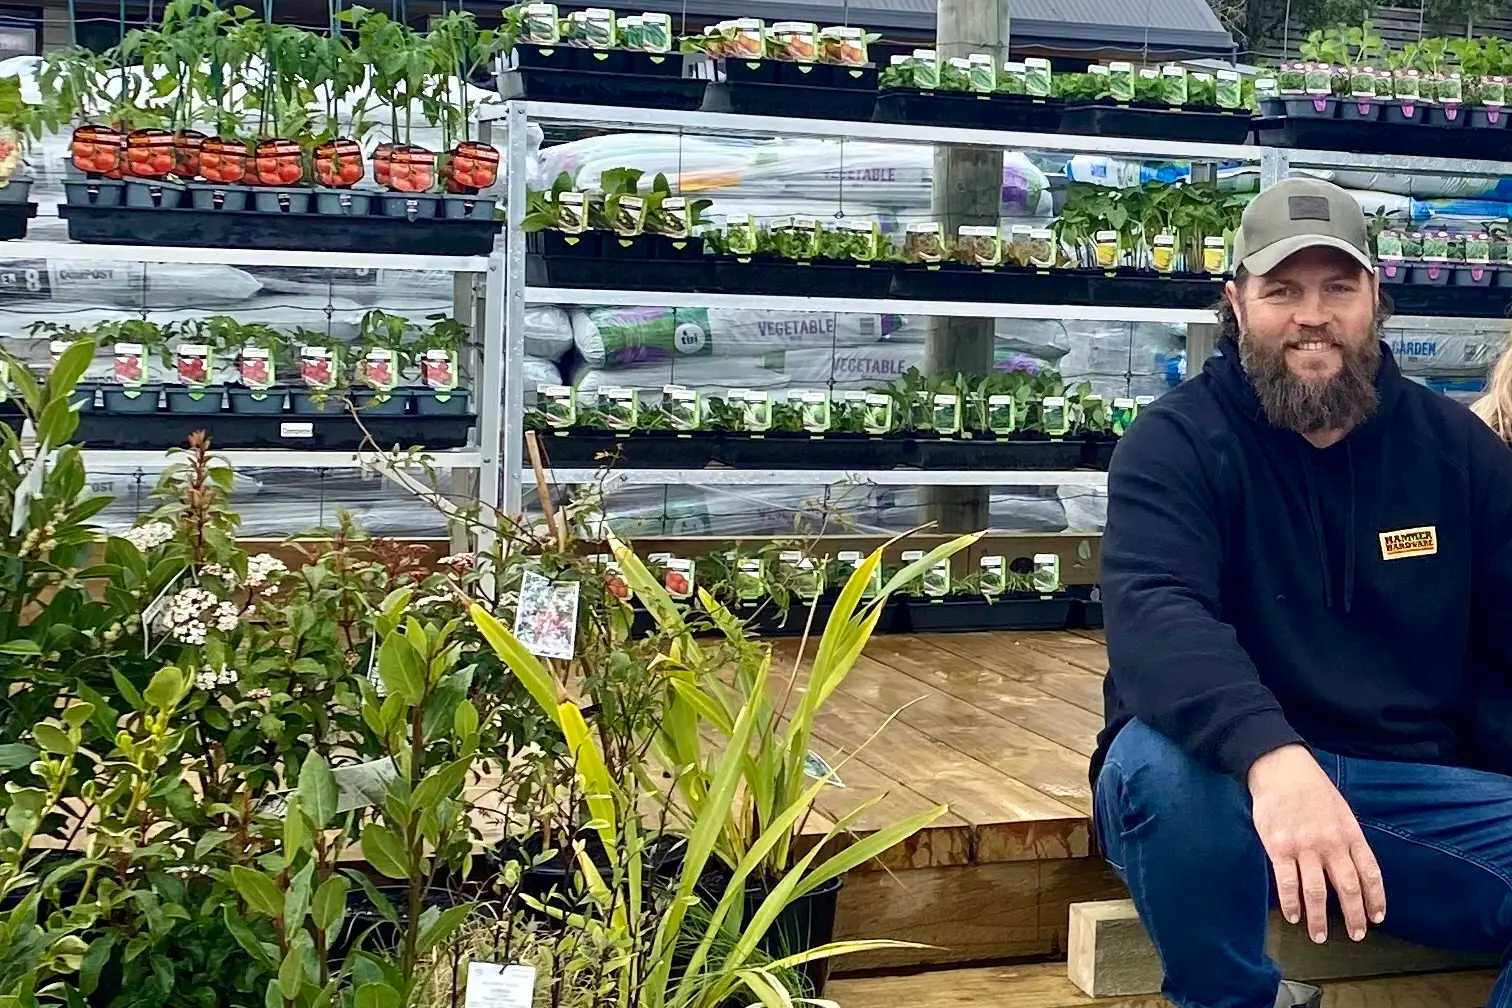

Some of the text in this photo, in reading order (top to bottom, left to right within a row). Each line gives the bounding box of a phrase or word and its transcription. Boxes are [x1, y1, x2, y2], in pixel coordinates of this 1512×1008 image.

[757, 318, 834, 336] VEGETABLE
[681, 332, 699, 345] tui
[1392, 339, 1437, 356] GARDEN
[833, 357, 906, 374] VEGETABLE
[85, 482, 113, 492] OST
[1384, 531, 1433, 544] HAMMER
[1385, 539, 1433, 552] HARDWARE
